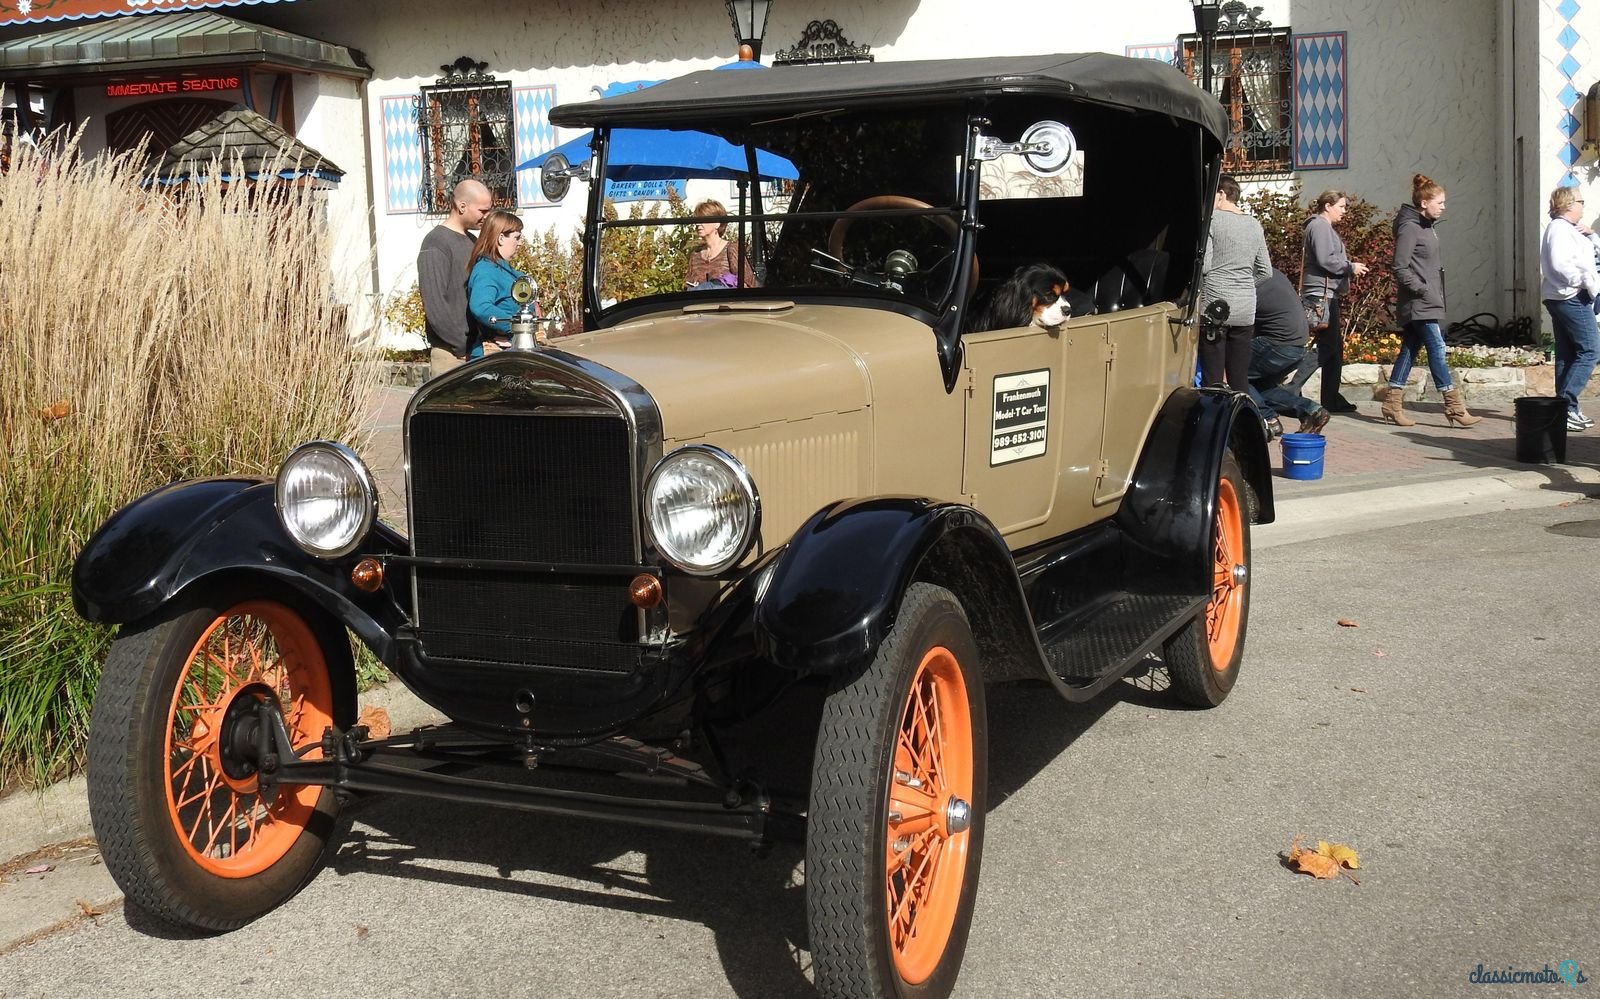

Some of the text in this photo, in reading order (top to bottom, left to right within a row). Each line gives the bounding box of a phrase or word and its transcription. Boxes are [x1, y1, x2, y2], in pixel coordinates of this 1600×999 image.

[107, 82, 177, 96] IMMEDIATE
[611, 182, 636, 190] BAKERY
[633, 189, 654, 197] CANDY
[1003, 388, 1041, 402] Frankenmuth
[995, 404, 1046, 420] Model-T Car Tour
[994, 429, 1045, 448] 989-652-3101
